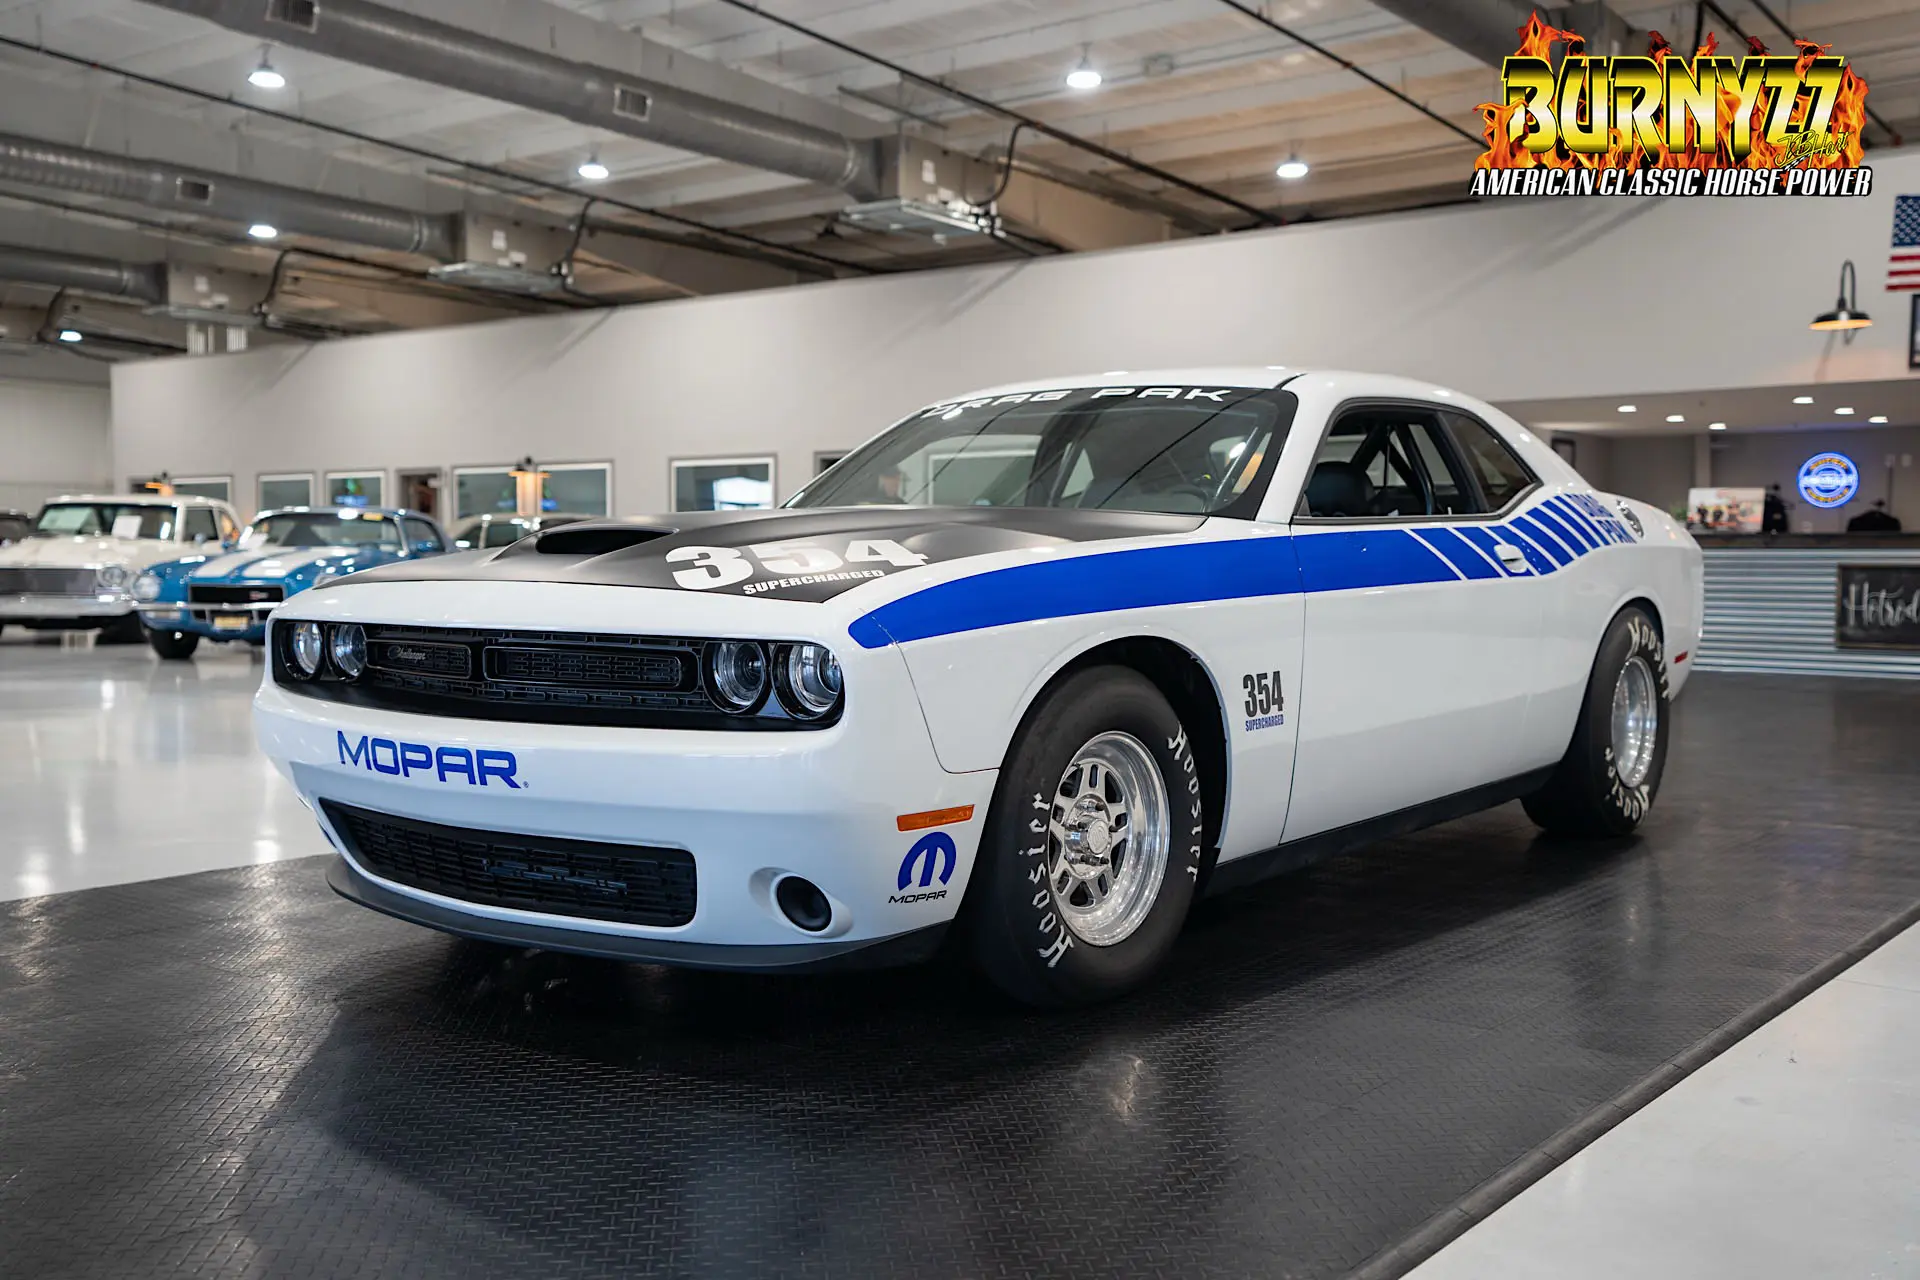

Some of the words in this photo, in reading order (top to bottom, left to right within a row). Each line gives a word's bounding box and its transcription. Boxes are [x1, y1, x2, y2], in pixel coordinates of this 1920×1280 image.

[1091, 387, 1234, 402] PAK
[665, 539, 929, 590] 354
[742, 569, 886, 595] SUPERCHARGED
[1242, 670, 1284, 718] 354
[337, 730, 521, 789] MOPAR
[888, 890, 947, 904] MOPAR
